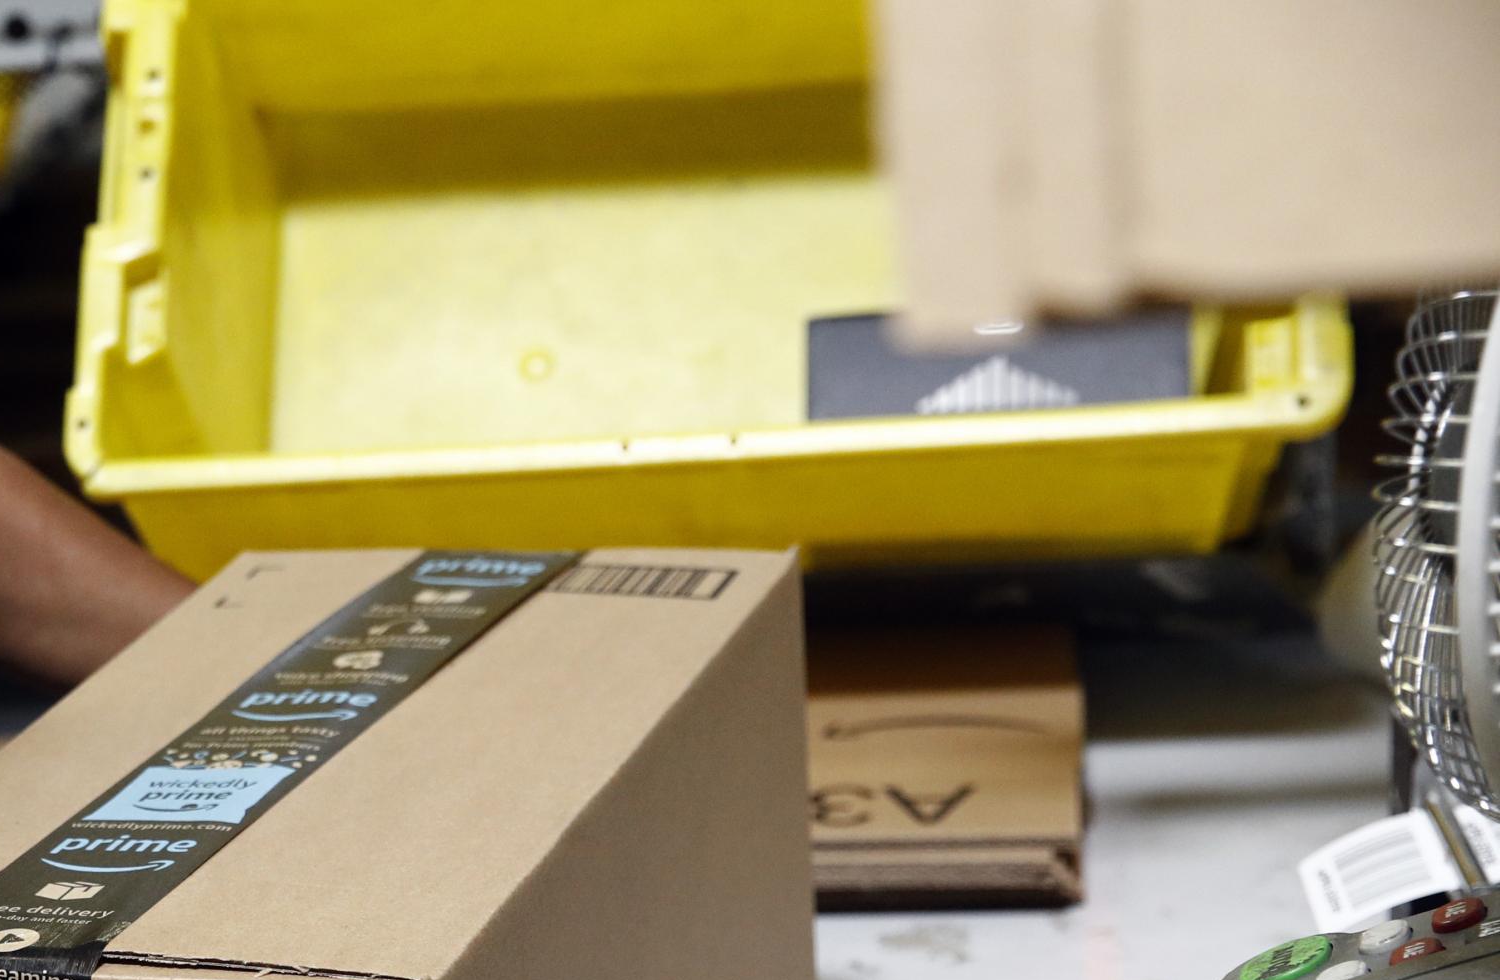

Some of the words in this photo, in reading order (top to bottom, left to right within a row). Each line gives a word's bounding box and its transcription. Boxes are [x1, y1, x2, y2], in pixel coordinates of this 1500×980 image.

[414, 556, 546, 576] prime
[239, 688, 379, 709] prime
[149, 777, 258, 791] wickedly
[138, 789, 234, 802] prime
[71, 820, 233, 833] wickedlyprime.com
[49, 834, 198, 855] prime
[26, 904, 116, 920] delivery
[30, 916, 53, 924] and
[56, 917, 93, 926] faster
